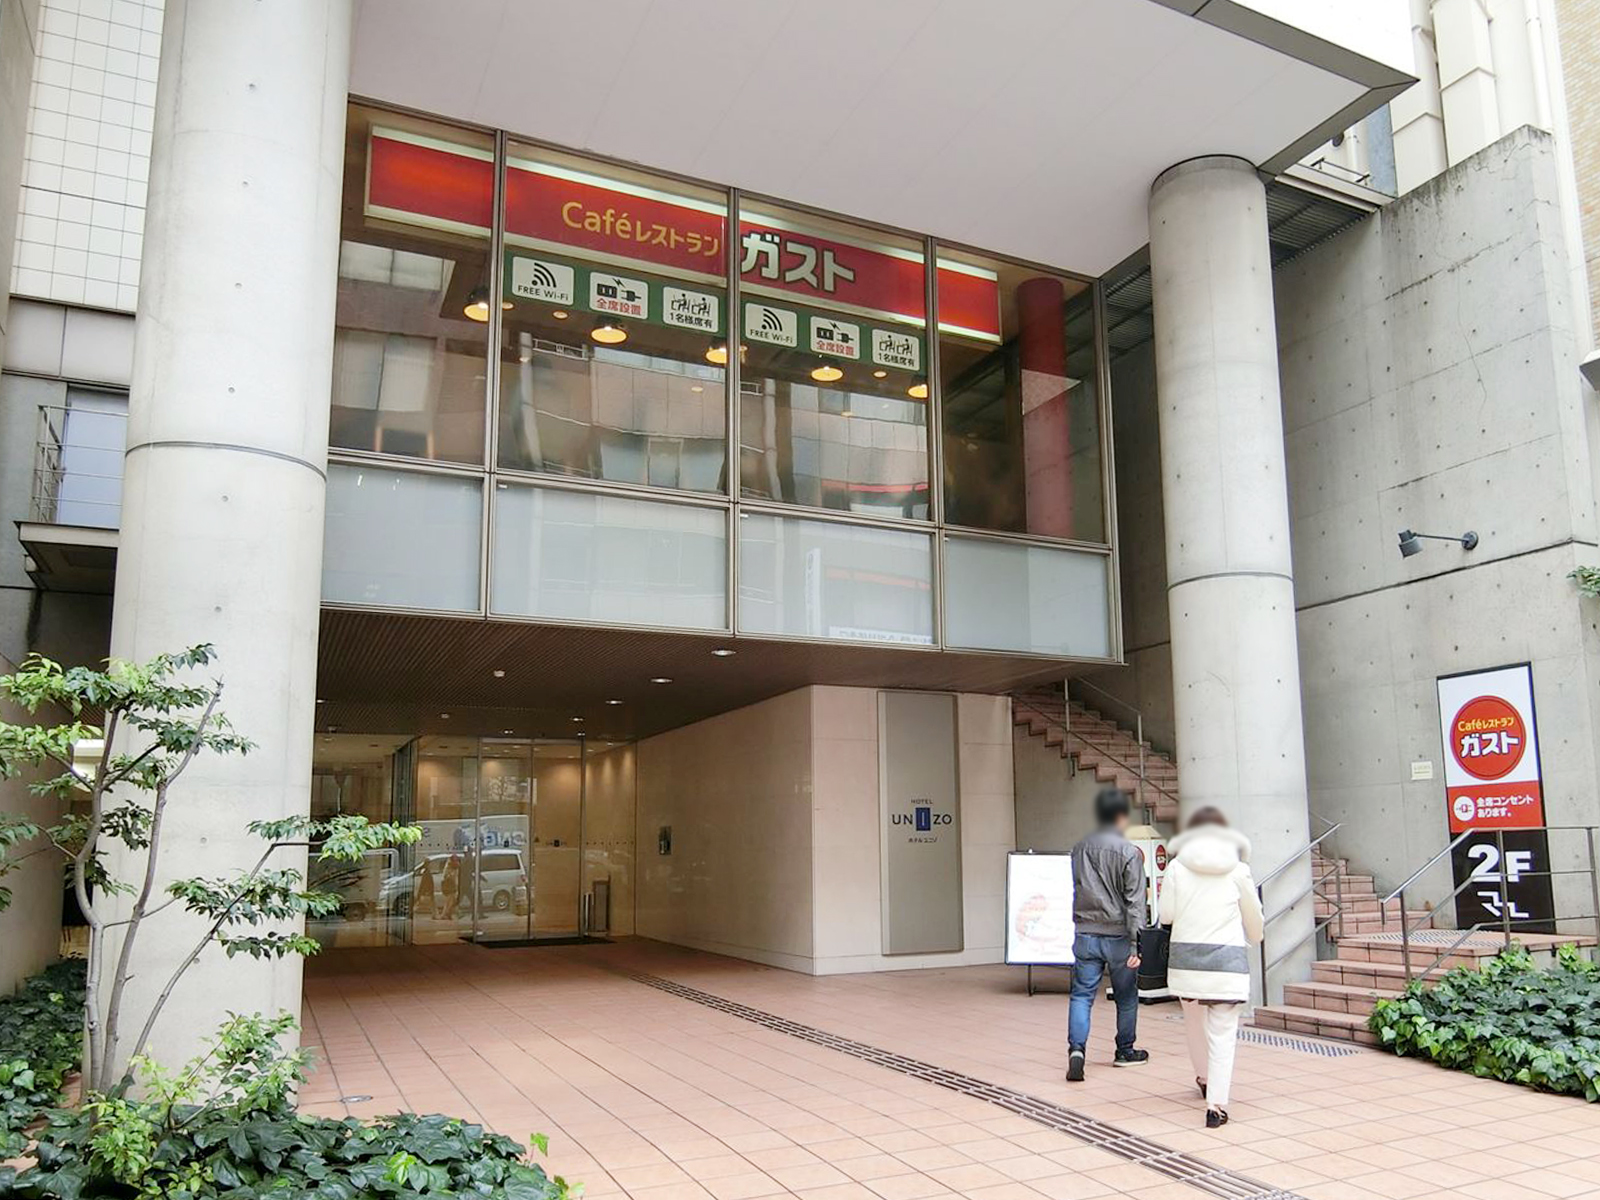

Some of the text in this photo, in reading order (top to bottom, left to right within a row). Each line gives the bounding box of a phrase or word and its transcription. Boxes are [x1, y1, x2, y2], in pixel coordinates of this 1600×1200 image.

[561, 201, 856, 293] Caféレストラン ガスト
[517, 284, 569, 302] FREE Wi-Fi
[596, 297, 642, 317] 全席設置
[669, 311, 713, 329] 1名様席有
[749, 328, 794, 345] FREE Wi-Fi
[1457, 716, 1515, 732] Caféレストラン
[1460, 730, 1520, 758] ガスト
[891, 810, 953, 828] UNIZO
[1467, 843, 1532, 882] 2F
